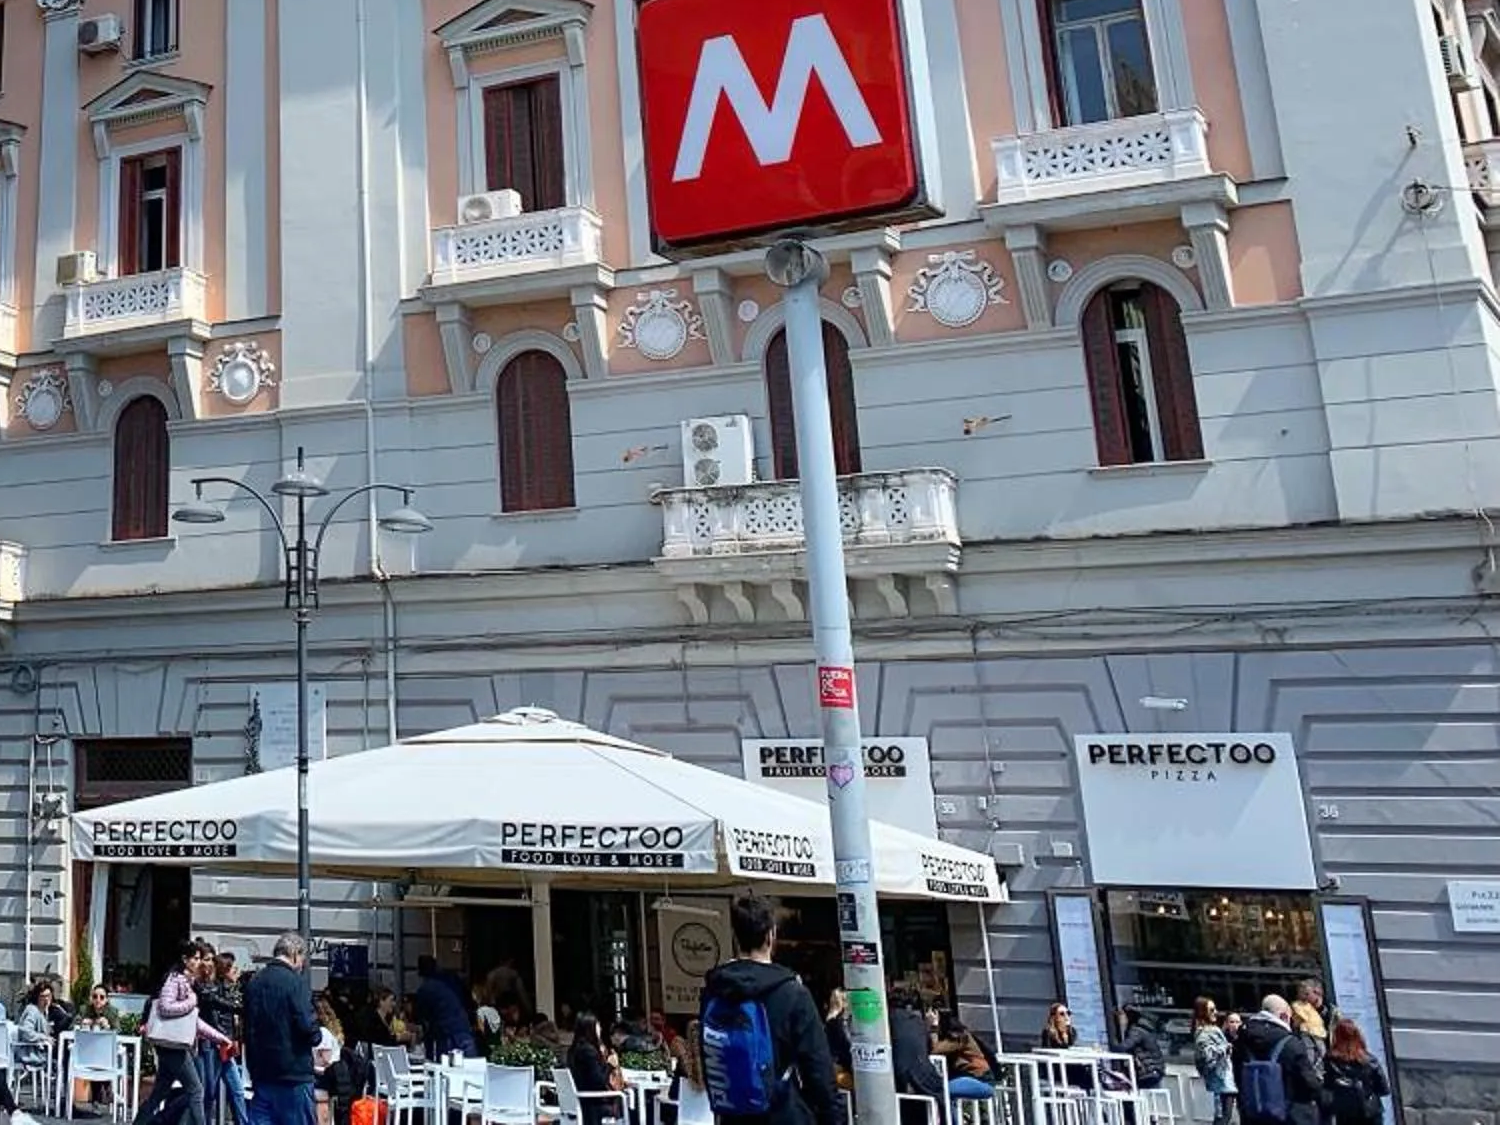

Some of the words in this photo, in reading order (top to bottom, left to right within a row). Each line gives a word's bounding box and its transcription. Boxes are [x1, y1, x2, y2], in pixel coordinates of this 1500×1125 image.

[672, 13, 883, 183] M
[759, 745, 905, 764] PERFTOO
[1087, 743, 1276, 765] PERFECTOO
[1151, 771, 1217, 781] PIZZA
[93, 819, 237, 842] PERFECTOO
[501, 822, 683, 849] PERFECTOO
[141, 846, 171, 856] LOVE
[179, 846, 186, 856] &
[194, 846, 229, 856] MORE
[511, 850, 554, 864] FOOD
[563, 852, 600, 865] LOVE
[610, 854, 619, 866] &
[629, 854, 674, 866] MORE
[703, 1026, 736, 1109] PUMA
